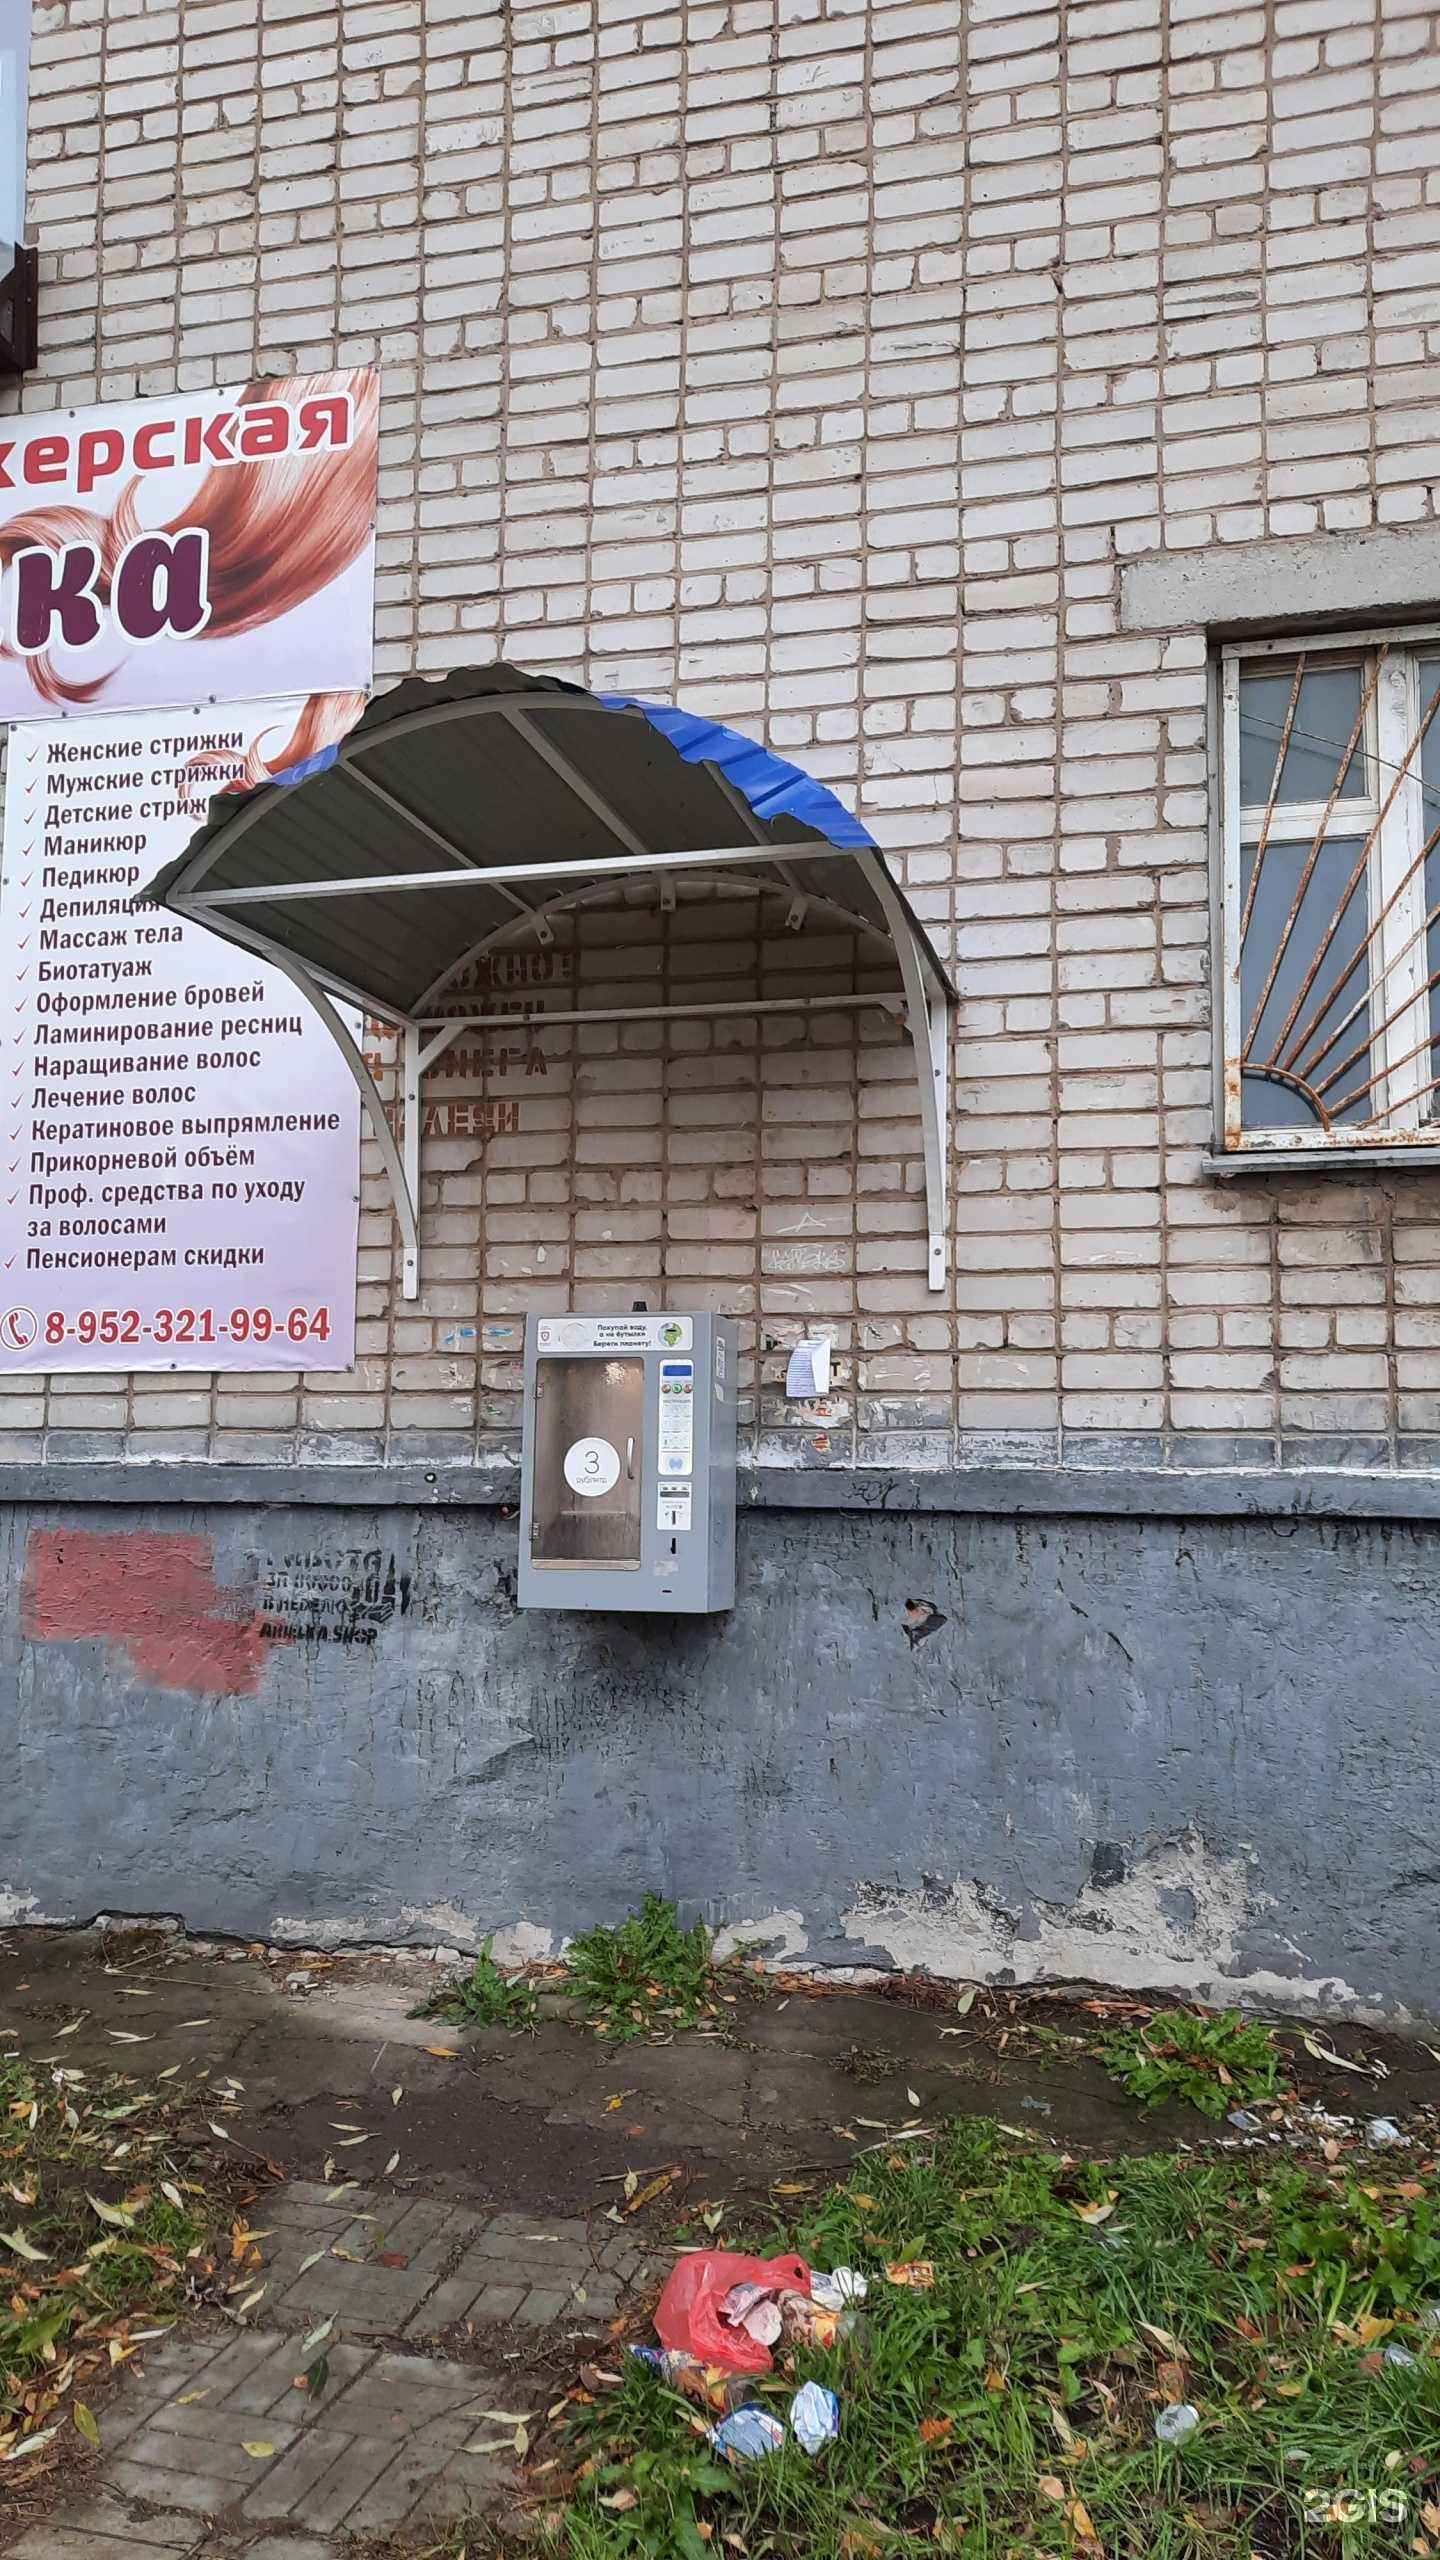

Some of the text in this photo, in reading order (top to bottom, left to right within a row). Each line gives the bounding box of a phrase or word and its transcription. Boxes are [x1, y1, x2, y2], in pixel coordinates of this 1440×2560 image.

[16, 534, 208, 649] ка
[47, 732, 244, 764] Женские стрижки
[46, 763, 246, 798] Мужские стрижки
[44, 798, 207, 829] Детские стриж
[44, 833, 147, 857] Маникюр
[42, 865, 140, 889] Педикюр
[39, 925, 183, 951] Массаж тела
[38, 959, 152, 983] Биотатуаж
[36, 980, 265, 1017] Оформление бровей
[34, 1014, 303, 1047] Ламинирование ресниц
[34, 1049, 261, 1078] Наращивание волос
[31, 1084, 196, 1110] Лечение волос
[31, 1113, 340, 1144] Кератиновое выпрямление
[30, 1145, 255, 1177] Прикорневой объём
[29, 1180, 305, 1209] Проф. средства по уходу
[27, 1216, 167, 1237] за волосами
[26, 1247, 265, 1271] Пенсионерам скидки
[44, 1307, 331, 1345] 8-952-321-99-64
[584, 1450, 600, 1474] 3
